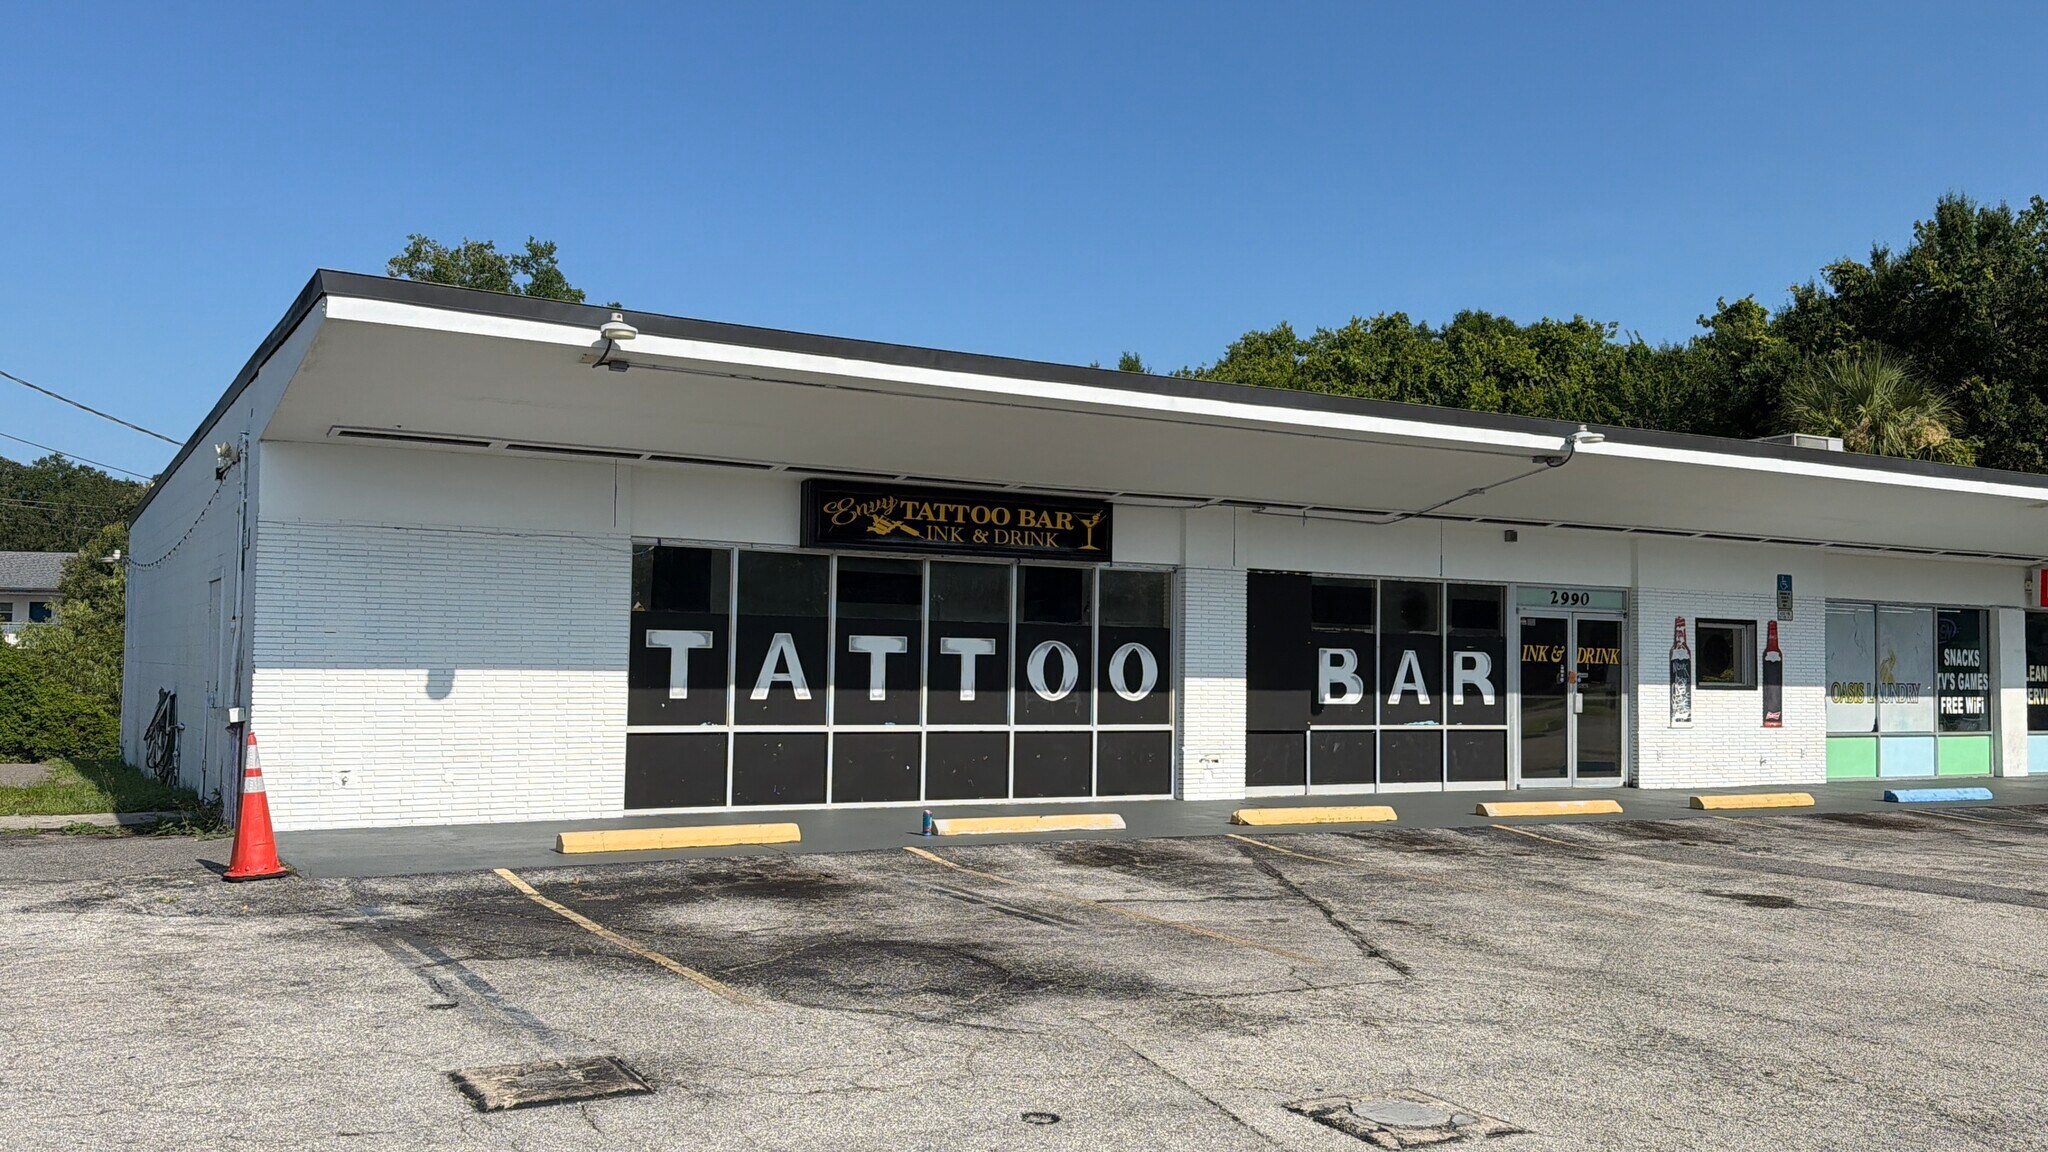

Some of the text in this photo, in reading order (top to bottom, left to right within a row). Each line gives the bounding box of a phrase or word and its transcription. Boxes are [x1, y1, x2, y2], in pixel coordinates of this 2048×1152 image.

[823, 496, 1075, 530] Envy TATTOO BAR
[926, 525, 1060, 548] INK & DRINK
[1550, 590, 1590, 606] 2990
[1521, 644, 1620, 665] INK & DRINK
[1944, 648, 1980, 667] SNACKS
[646, 630, 1495, 705] TATTOO BAR
[1937, 672, 1989, 690] TV'S GAMES
[1831, 681, 1865, 704] OASIS
[1940, 696, 1964, 714] FREE
